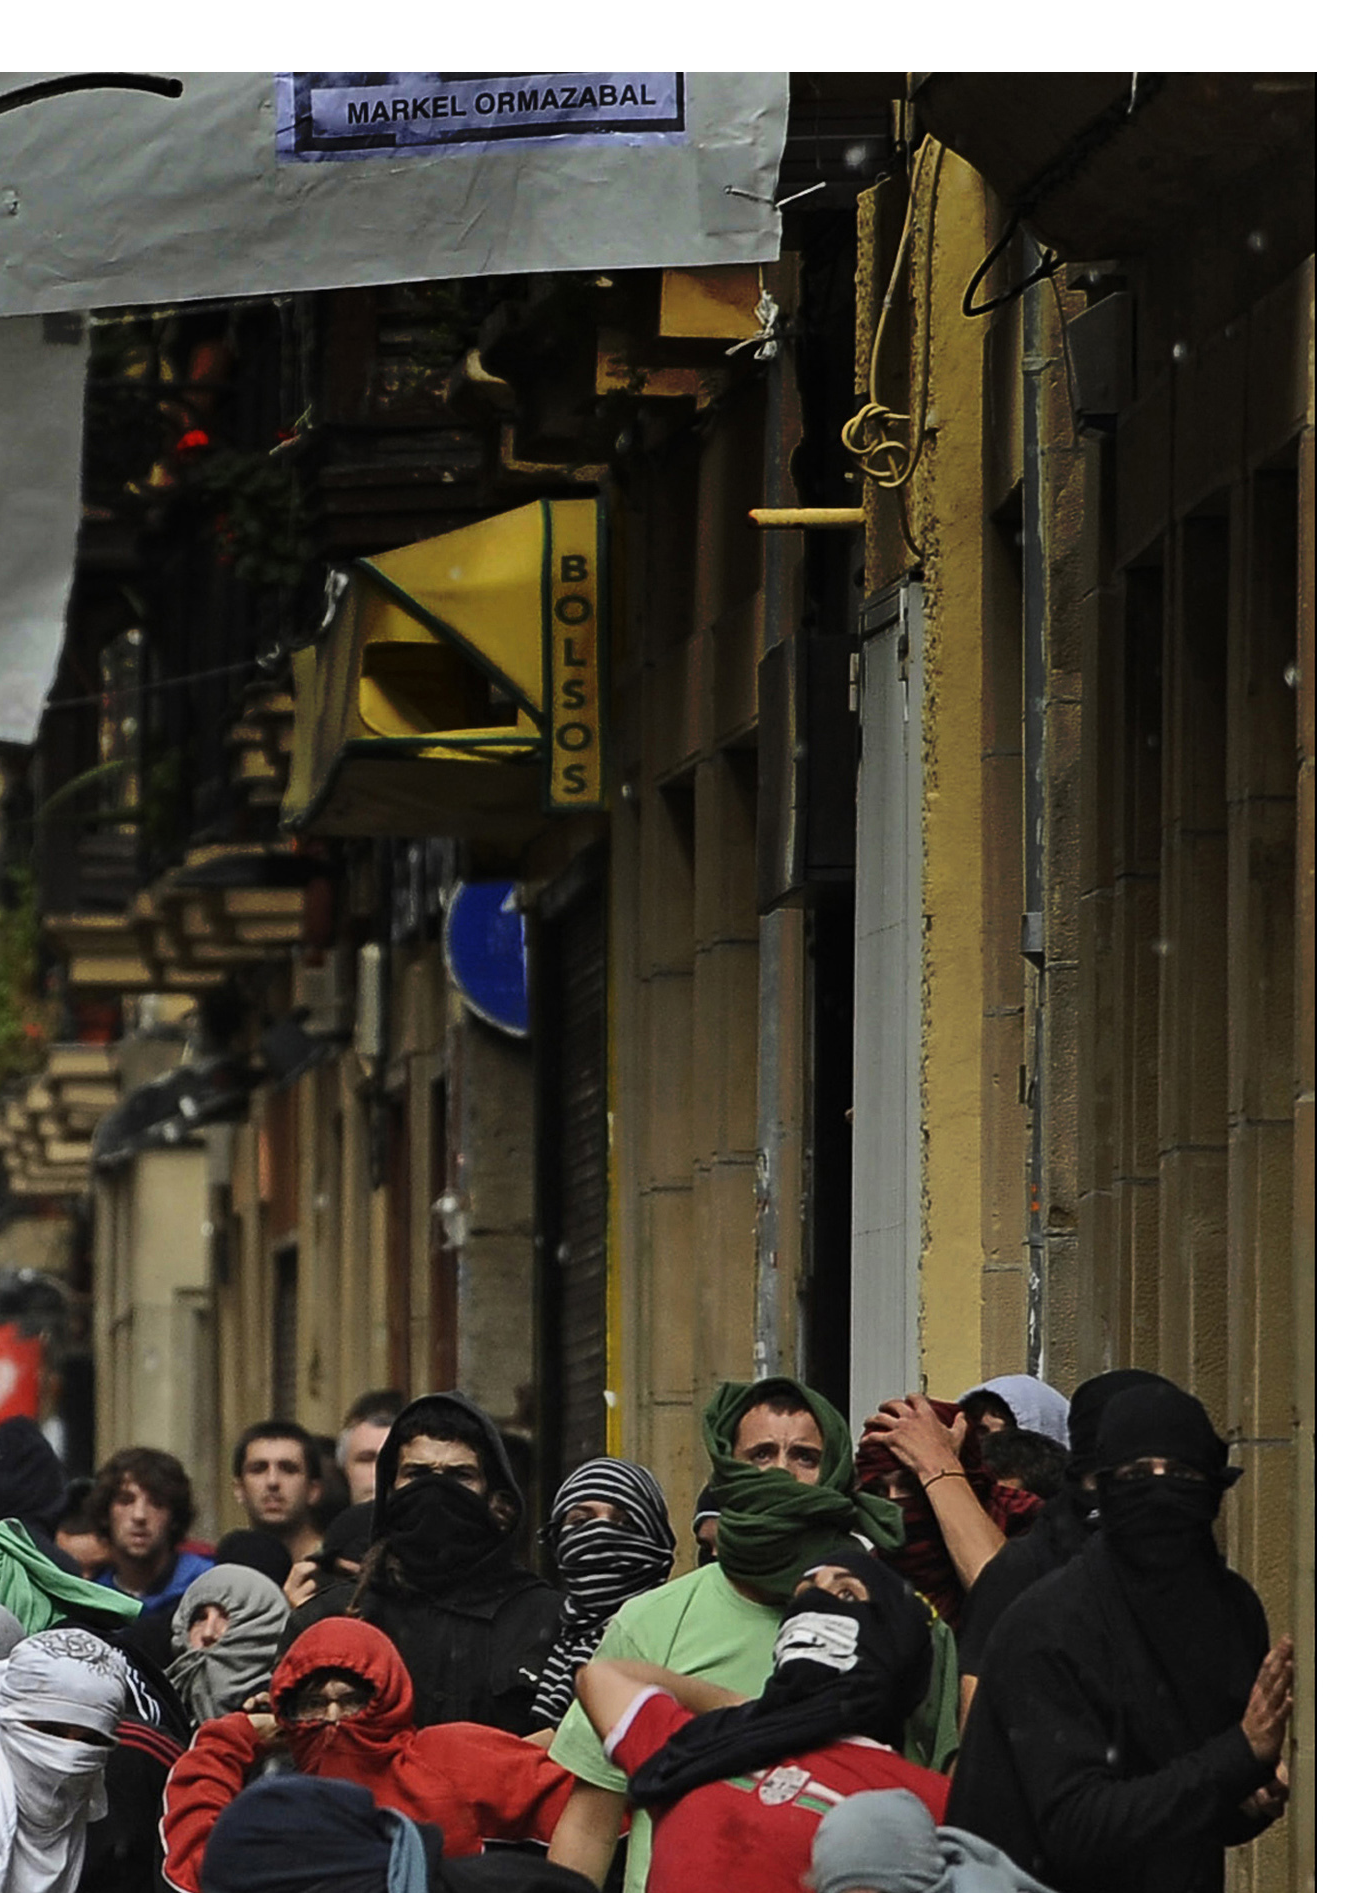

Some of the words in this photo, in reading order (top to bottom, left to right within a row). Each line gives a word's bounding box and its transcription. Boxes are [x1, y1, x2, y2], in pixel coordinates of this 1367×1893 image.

[347, 95, 465, 126] MARKEL
[472, 81, 657, 117] ORMAZABAL
[560, 553, 592, 795] BOLSOS
